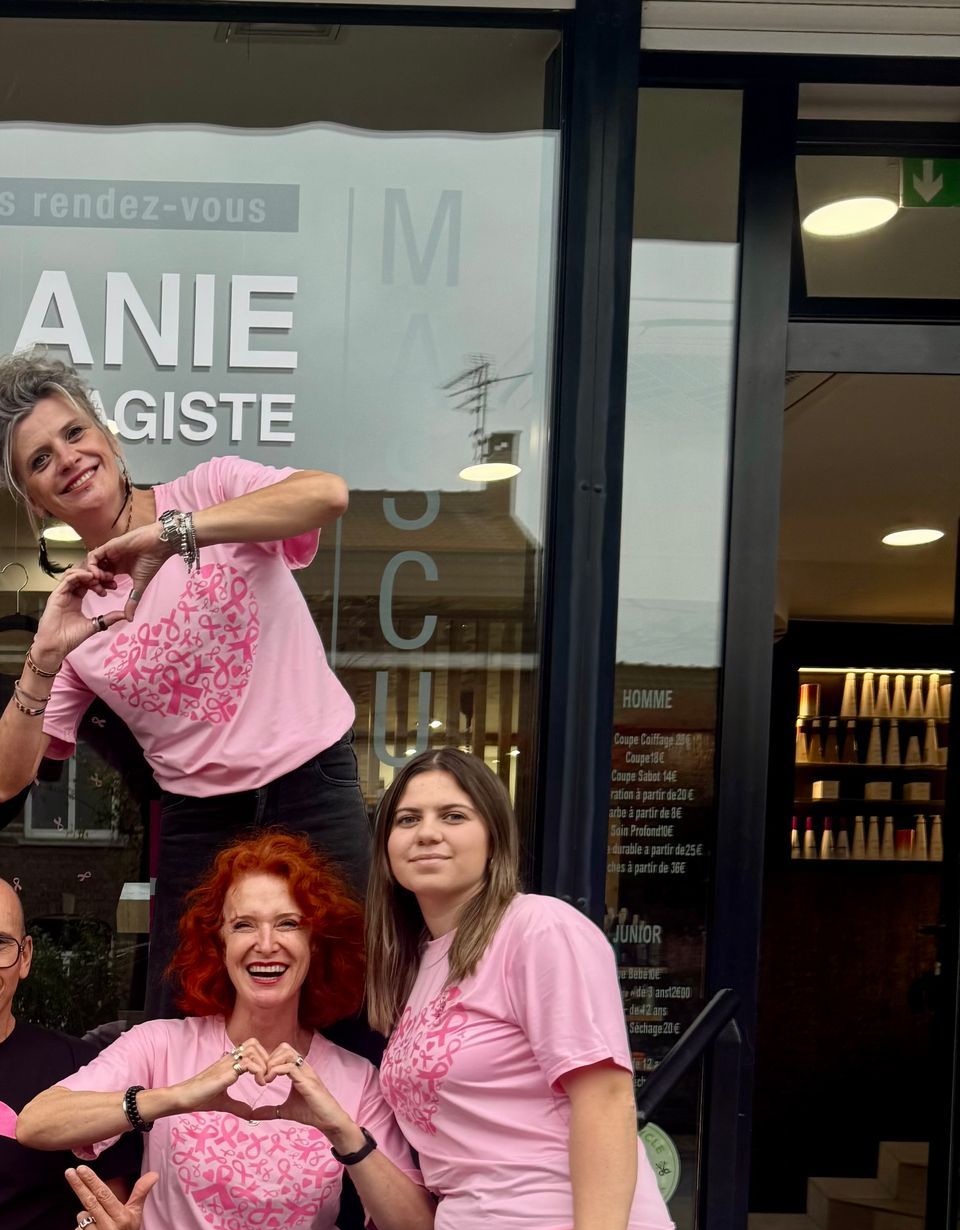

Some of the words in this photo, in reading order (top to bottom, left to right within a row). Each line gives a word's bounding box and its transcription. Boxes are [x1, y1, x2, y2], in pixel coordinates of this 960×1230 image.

[33, 187, 266, 224] rendez-vous
[623, 689, 673, 709] HOMME
[614, 733, 639, 748] Coupe
[640, 733, 673, 750] Coiffage
[611, 769, 636, 785] Coupe
[637, 769, 661, 782] Sabot
[642, 789, 666, 803] partir
[635, 807, 659, 821] partir
[660, 807, 670, 819] de
[610, 824, 628, 837] Soin
[613, 843, 643, 856] durable
[651, 844, 674, 858] partir
[634, 861, 658, 876] partir
[659, 862, 668, 874] de
[613, 924, 662, 944] JUNIOR
[653, 1006, 667, 1016] ans
[629, 1022, 663, 1037] Séchage
